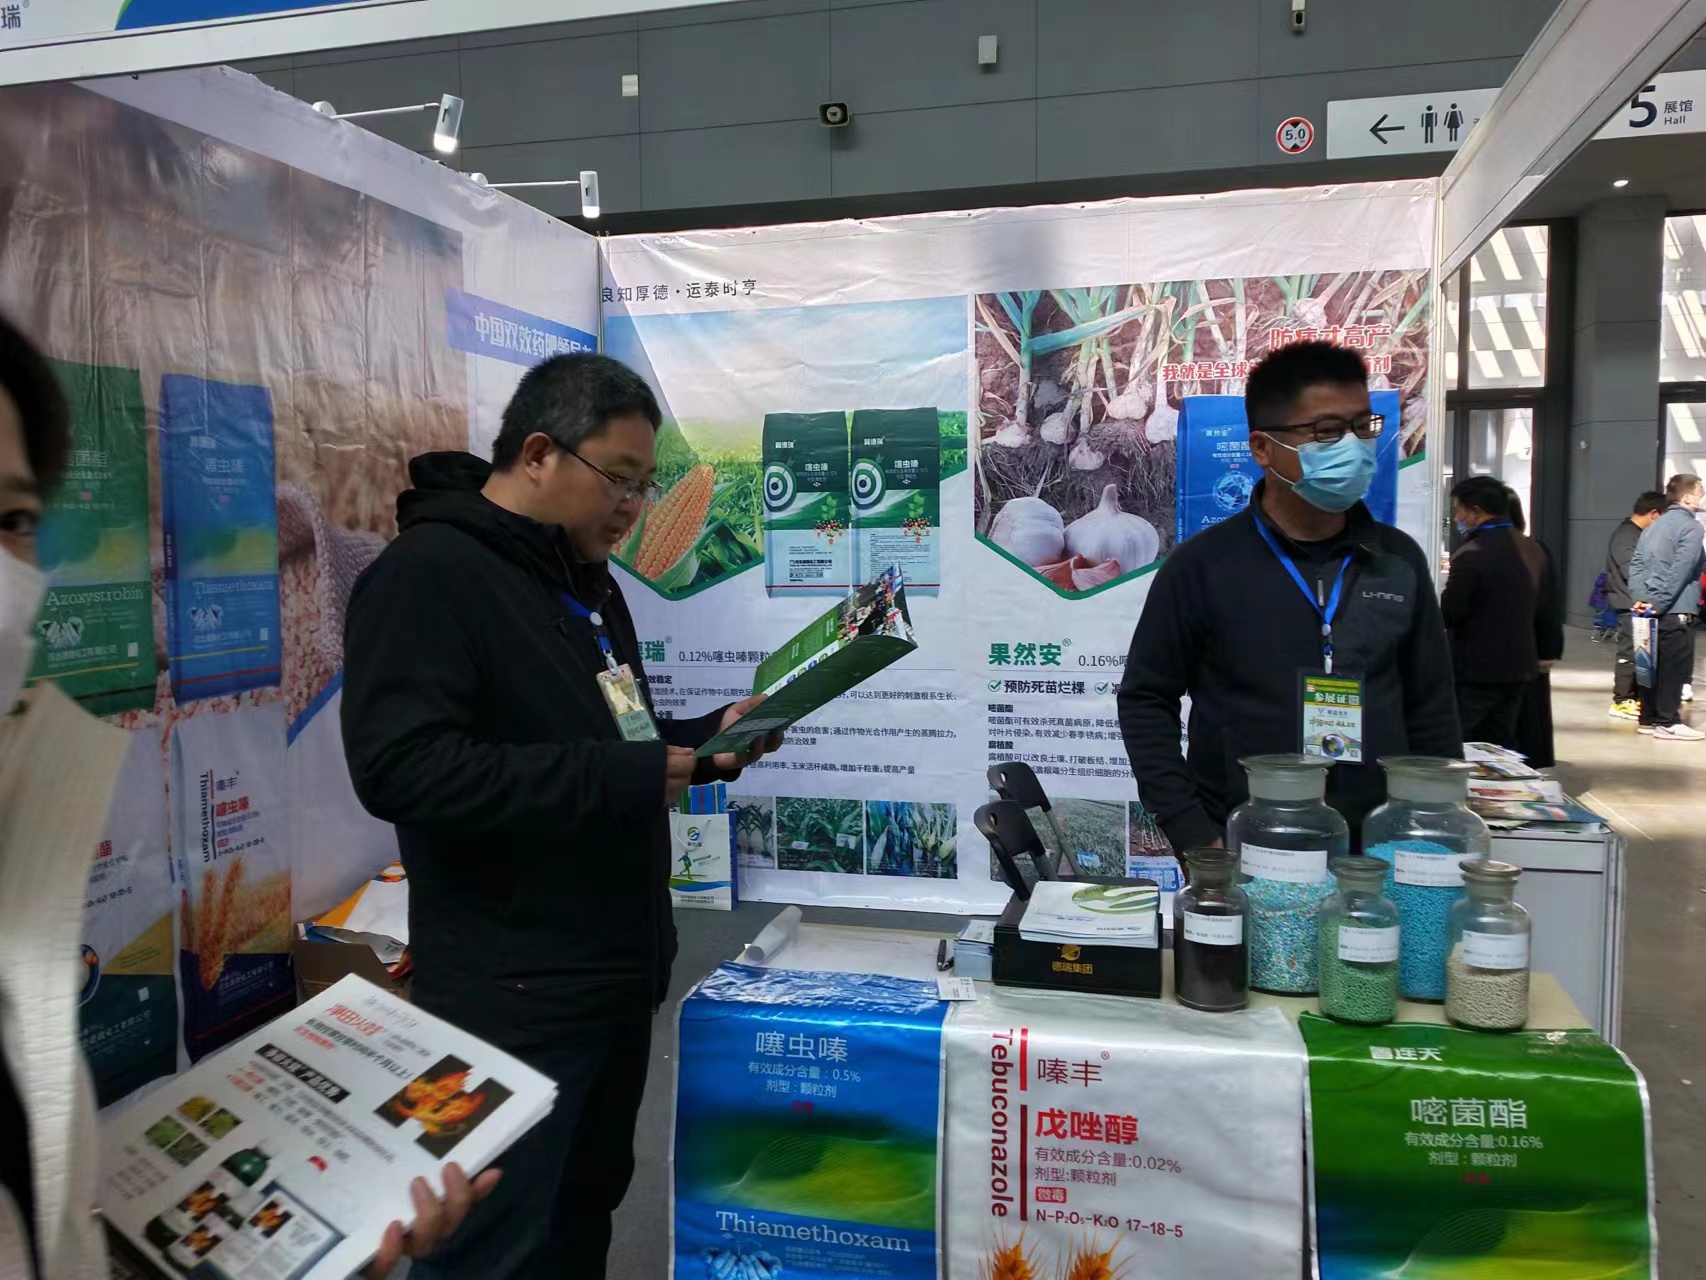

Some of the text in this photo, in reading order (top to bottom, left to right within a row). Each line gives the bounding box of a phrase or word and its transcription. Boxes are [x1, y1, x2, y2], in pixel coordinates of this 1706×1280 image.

[1629, 85, 1658, 128] 5
[1664, 99, 1694, 113] 展馆
[1664, 116, 1686, 125] Hall
[1285, 128, 1306, 140] 5.0
[679, 650, 775, 664] 0.12%噻虫嗪颗粒
[989, 643, 1062, 666] 果然安
[1004, 680, 1086, 695] 预防死苗烂棵
[1052, 961, 1093, 975] 德瑞集团
[756, 1031, 848, 1062] 噻虫嗪
[1037, 1058, 1103, 1087] 嗪丰
[991, 1029, 1014, 1218] Tebuconazole
[1410, 1097, 1528, 1129] 嘧菌酯
[715, 1211, 911, 1252] Thiamethoxam
[1126, 1218, 1184, 1238] 17-18-5
